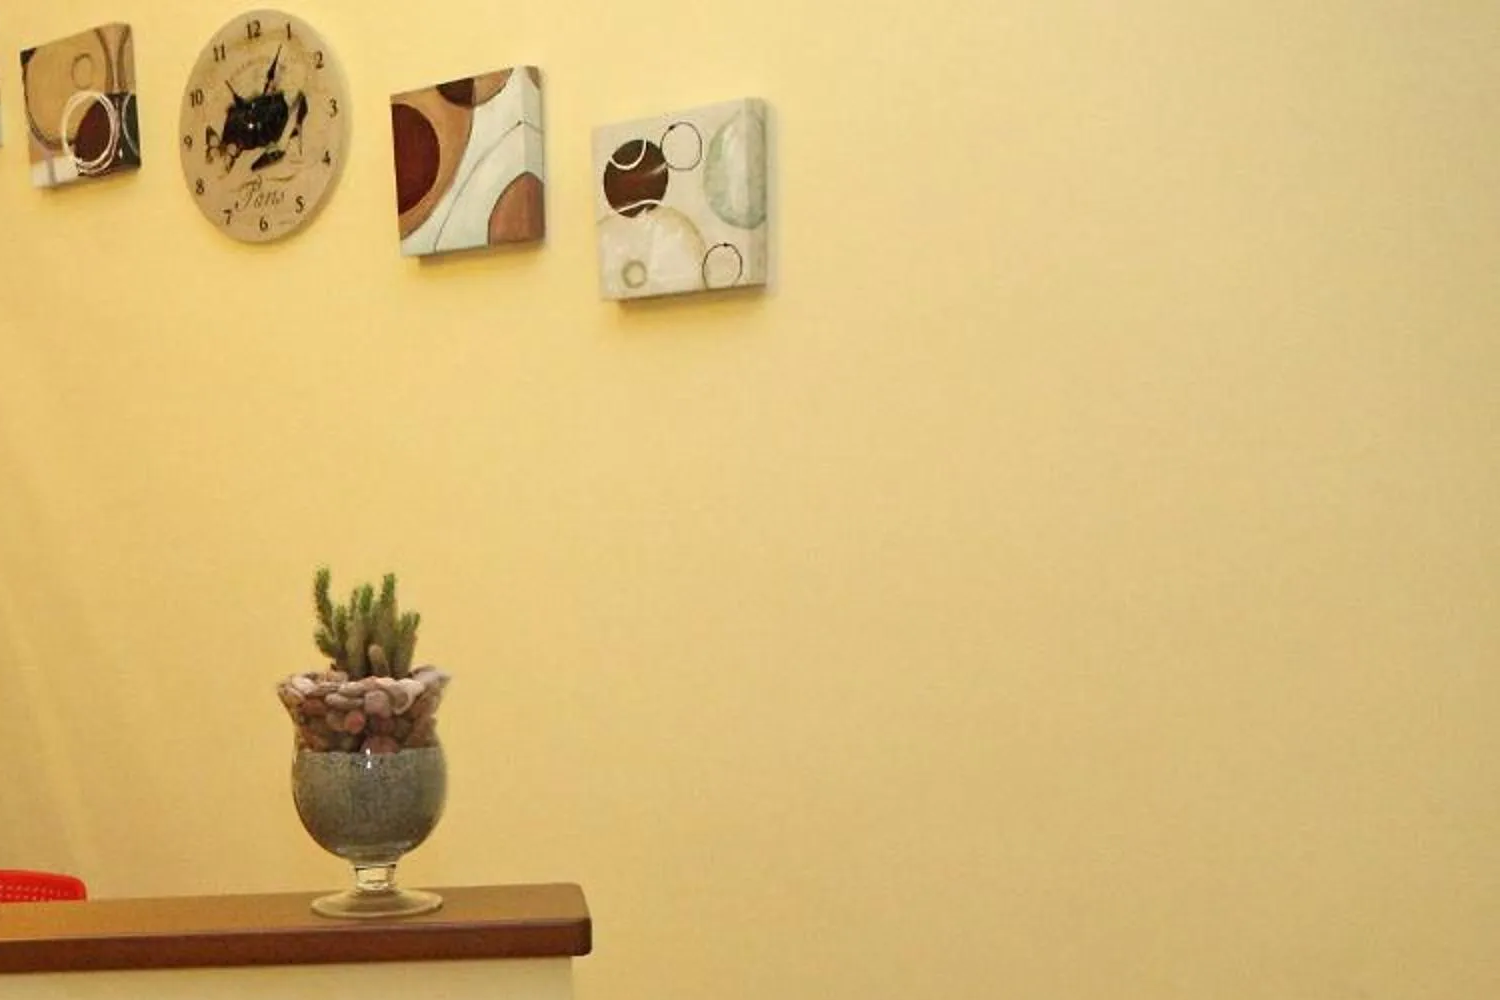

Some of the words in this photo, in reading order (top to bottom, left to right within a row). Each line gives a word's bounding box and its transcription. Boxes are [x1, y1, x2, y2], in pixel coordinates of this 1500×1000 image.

[246, 20, 261, 39] 12
[285, 23, 293, 40] 1
[212, 43, 226, 62] 11
[315, 51, 324, 69] 2
[189, 89, 204, 107] 10
[329, 99, 338, 118] 3
[183, 135, 193, 152] 9
[322, 151, 331, 168] 4
[196, 179, 205, 195] 8
[295, 196, 305, 214] 5
[223, 209, 233, 225] 7
[259, 216, 268, 232] 6
